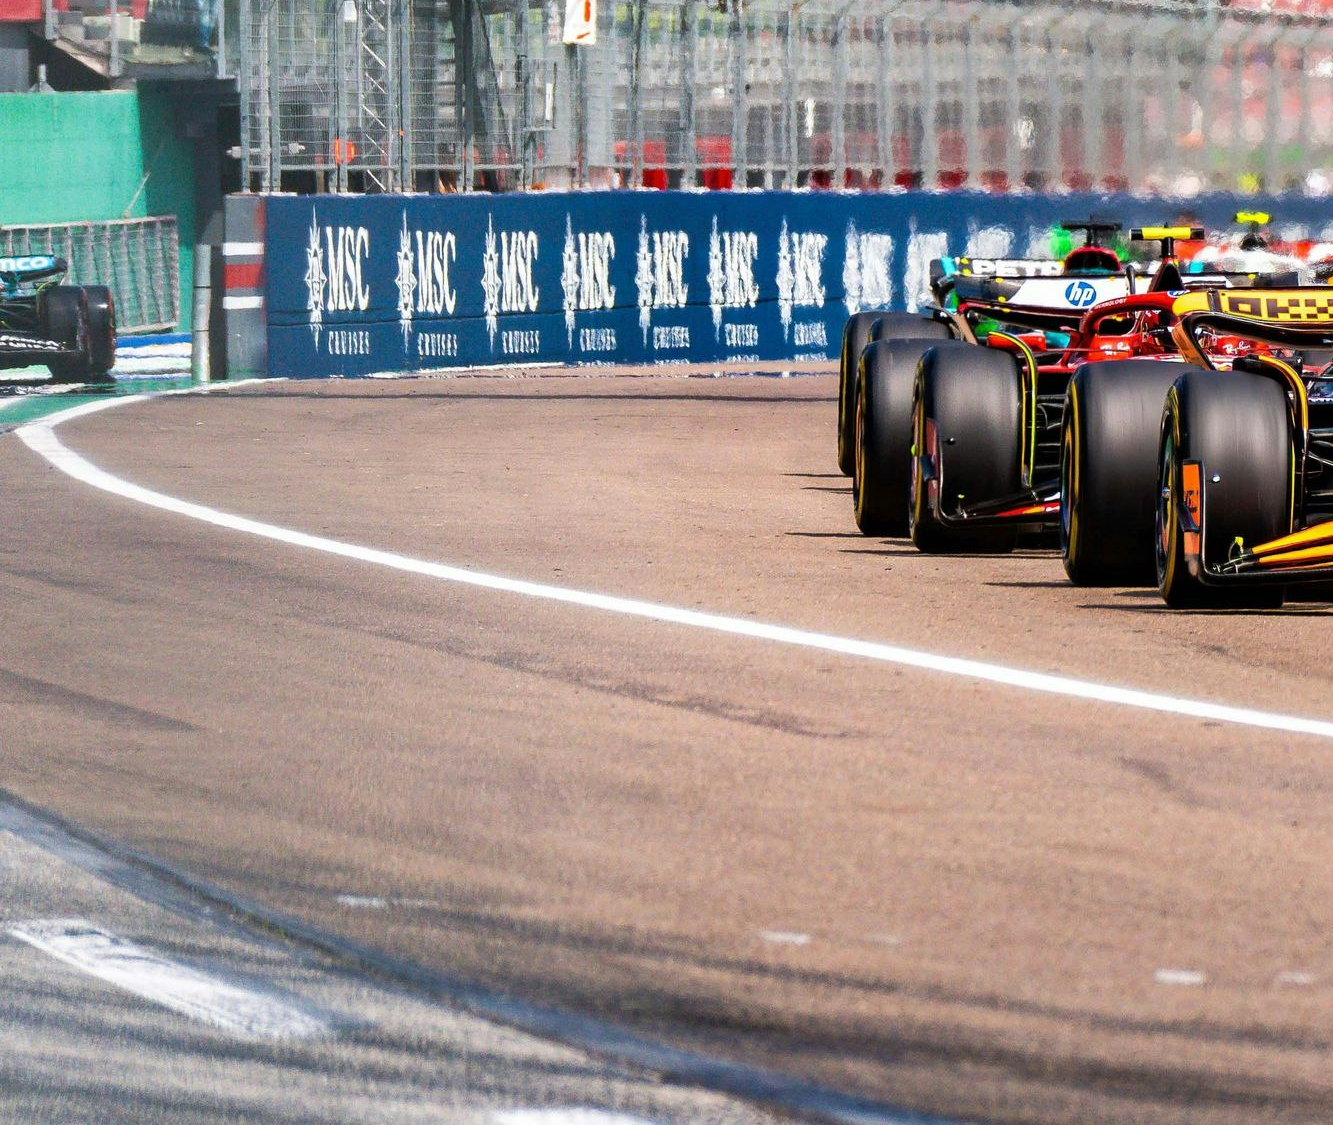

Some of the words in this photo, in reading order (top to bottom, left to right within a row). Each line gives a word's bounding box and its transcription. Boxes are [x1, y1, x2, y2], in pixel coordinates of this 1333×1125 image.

[326, 226, 370, 312] MSC
[416, 230, 456, 315] MSC
[501, 230, 539, 313] MSC
[578, 232, 616, 310] MSC
[653, 231, 690, 309] MSC
[1068, 283, 1095, 304] hp
[328, 331, 370, 355] CRUISES
